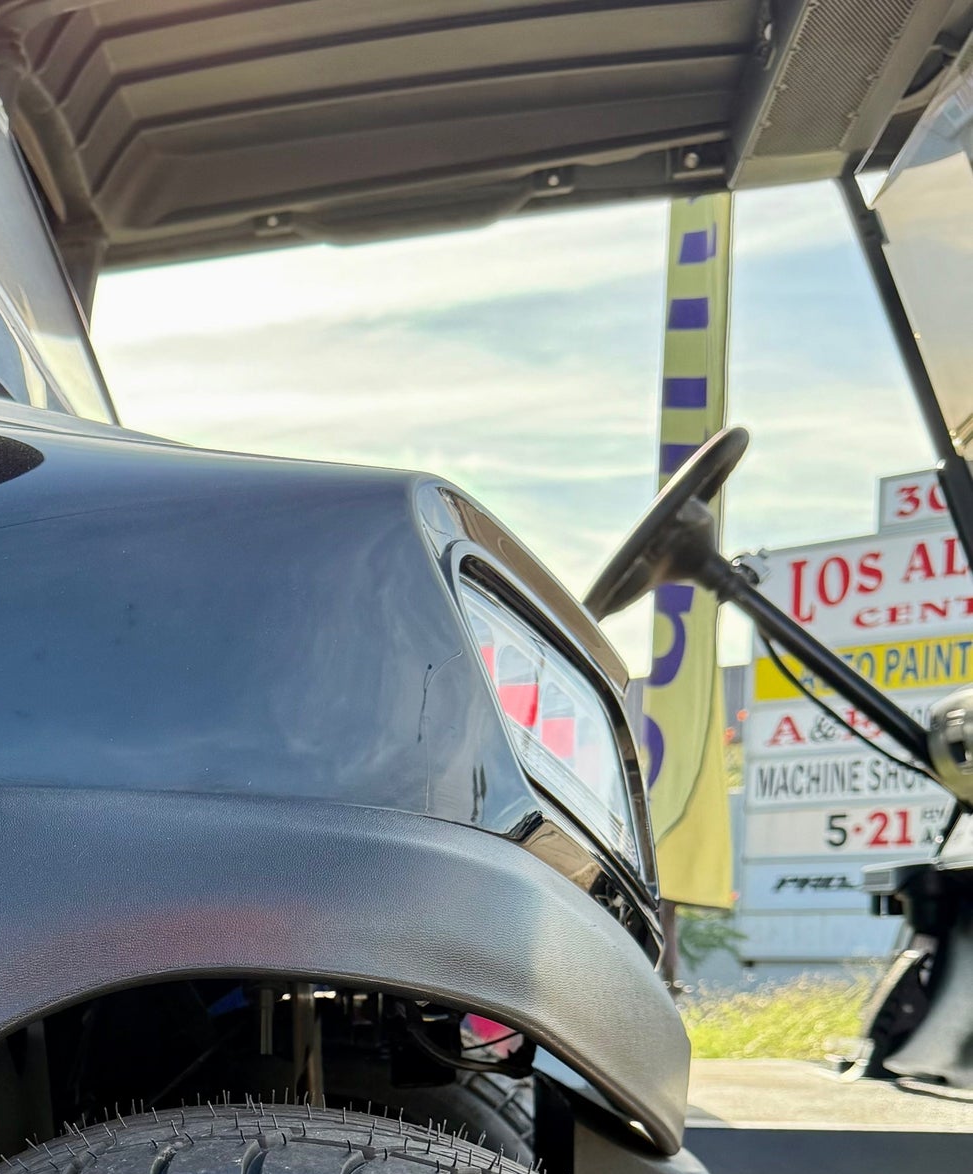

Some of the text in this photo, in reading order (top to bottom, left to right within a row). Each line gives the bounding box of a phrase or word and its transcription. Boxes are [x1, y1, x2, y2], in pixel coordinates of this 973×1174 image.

[789, 537, 970, 624] LOS AL
[754, 759, 861, 798] MACHINE
